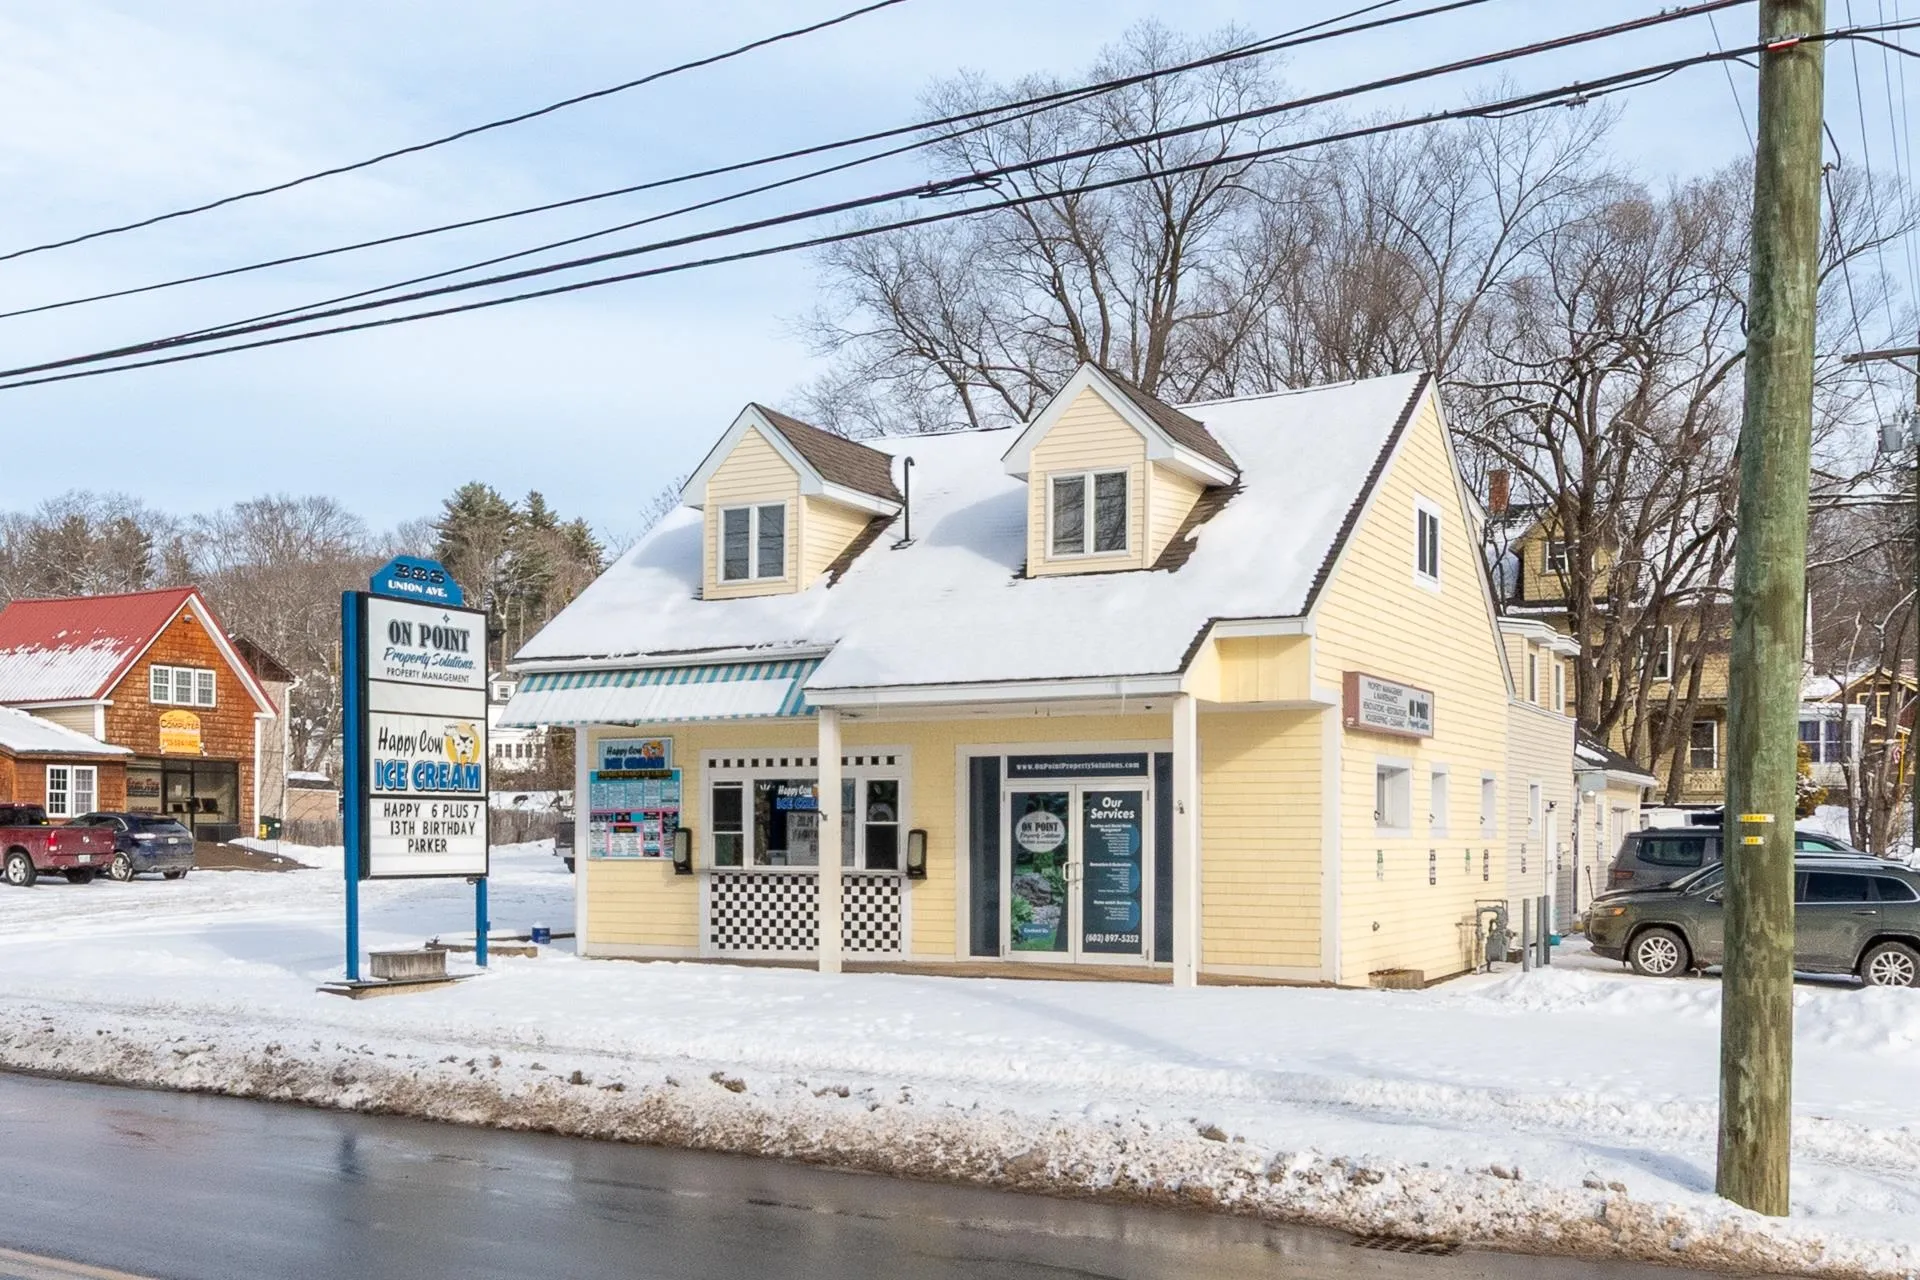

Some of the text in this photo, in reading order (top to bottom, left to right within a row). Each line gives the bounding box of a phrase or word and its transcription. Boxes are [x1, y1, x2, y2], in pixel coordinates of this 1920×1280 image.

[388, 579, 448, 598] UNION AVE.
[388, 619, 470, 653] ON POINT
[383, 647, 432, 669] Property
[386, 667, 470, 683] PROPERTY MANAGEMENT
[378, 726, 443, 757] Happy Cow
[607, 746, 627, 756] Happy
[374, 759, 481, 792] ICE CREAM
[778, 784, 798, 796] Happy
[1102, 796, 1123, 808] Our
[384, 803, 479, 818] HAPPY 6 PLUS 7
[1090, 808, 1135, 819] Services
[391, 821, 476, 835] 13TH BIRTHDAY
[1021, 822, 1058, 832] ON POINT
[408, 838, 448, 853] PARKER
